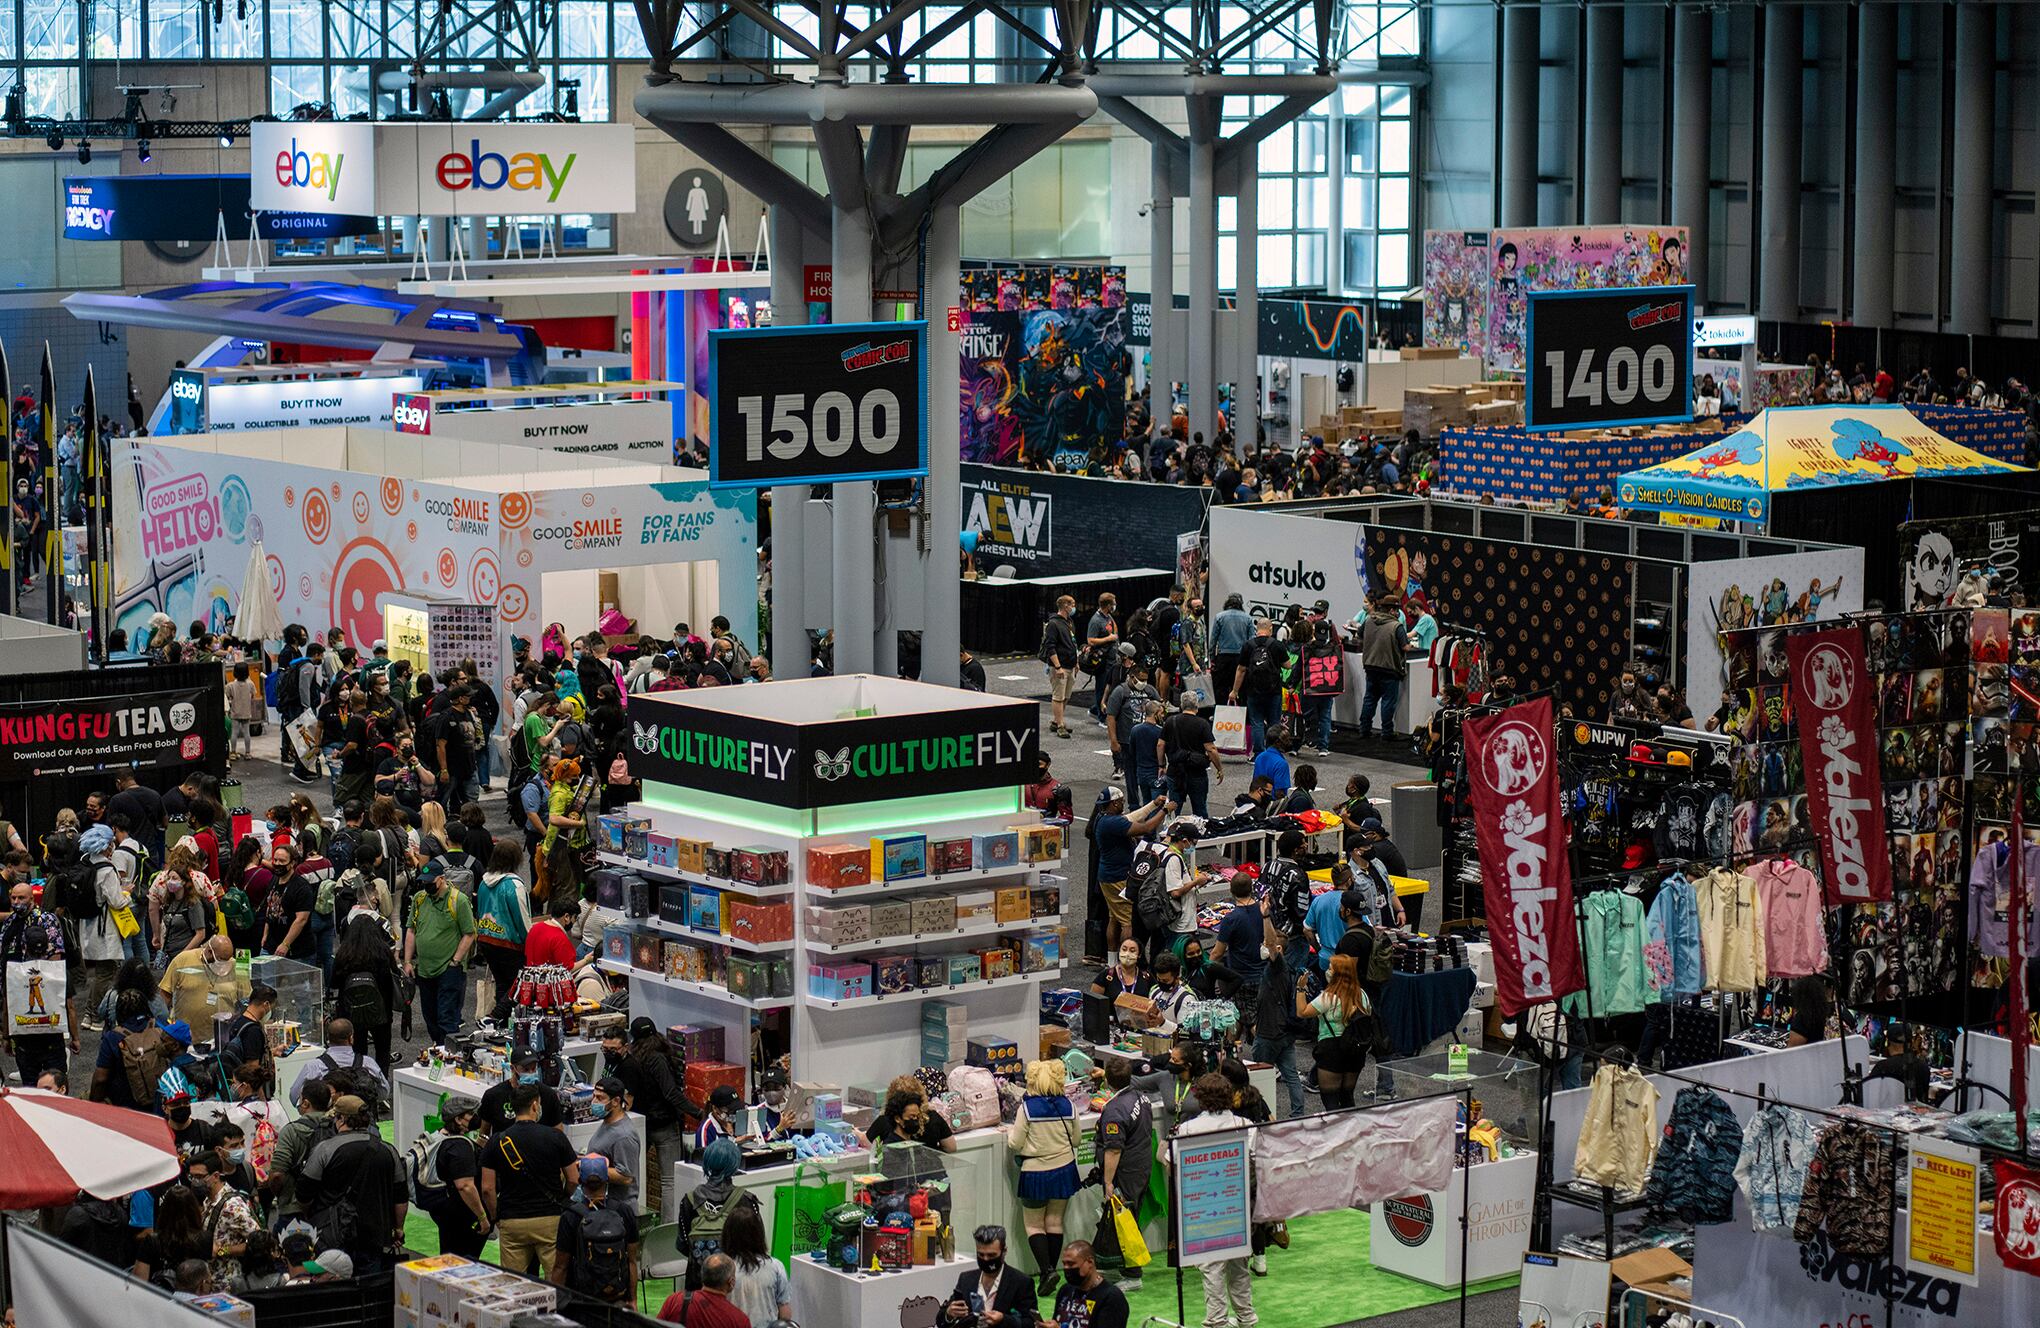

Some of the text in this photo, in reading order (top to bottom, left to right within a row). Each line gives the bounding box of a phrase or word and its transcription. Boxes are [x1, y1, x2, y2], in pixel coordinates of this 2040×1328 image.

[276, 137, 344, 202] ebay
[436, 138, 577, 203] ebay
[271, 217, 328, 229] ORIGINAL
[1584, 242, 1612, 251] tokidoki
[814, 271, 832, 282] FIR
[1132, 326, 1151, 337] STO
[1709, 328, 1745, 339] tokidoki
[846, 342, 909, 369] COMIC CON
[1545, 344, 1675, 409] 1400
[172, 377, 203, 404] ebay
[281, 397, 342, 410] BUY IT NOW
[244, 419, 300, 429] COLLECTIBLES
[309, 416, 343, 426] TRADING
[344, 414, 371, 424] CARDS
[393, 401, 429, 431] ebay
[737, 388, 900, 462] 1500
[523, 424, 589, 438] BUY IT NOW
[590, 443, 619, 453] CARDS
[628, 440, 664, 450] AUCTION
[1054, 451, 1089, 467] ebay
[151, 481, 204, 510] GOOD SMILE
[980, 480, 1030, 497] ALL ELITE
[1705, 492, 1743, 513] CANDLES
[141, 495, 224, 560] HELLO!
[642, 511, 715, 531] FOR FANS
[965, 492, 1047, 547] AEW
[1988, 520, 2006, 539] THE
[640, 526, 702, 545] BY FANS
[1249, 559, 1327, 592] atsuko
[115, 706, 166, 737] TEA
[1591, 728, 1626, 747] NJPW
[13, 738, 178, 760] Download Our App and Earn Free Boba!
[659, 725, 792, 782] CULTUREFLY
[852, 728, 1031, 778] CULTUREFLY
[1503, 812, 1557, 998] Valeza
[1184, 1147, 1240, 1165] HUGE DEALS
[1950, 1166, 1973, 1179] LIST
[1467, 1200, 1513, 1225] GAME
[1469, 1216, 1528, 1244] HRONES
[1815, 1230, 1961, 1317] Valeza
